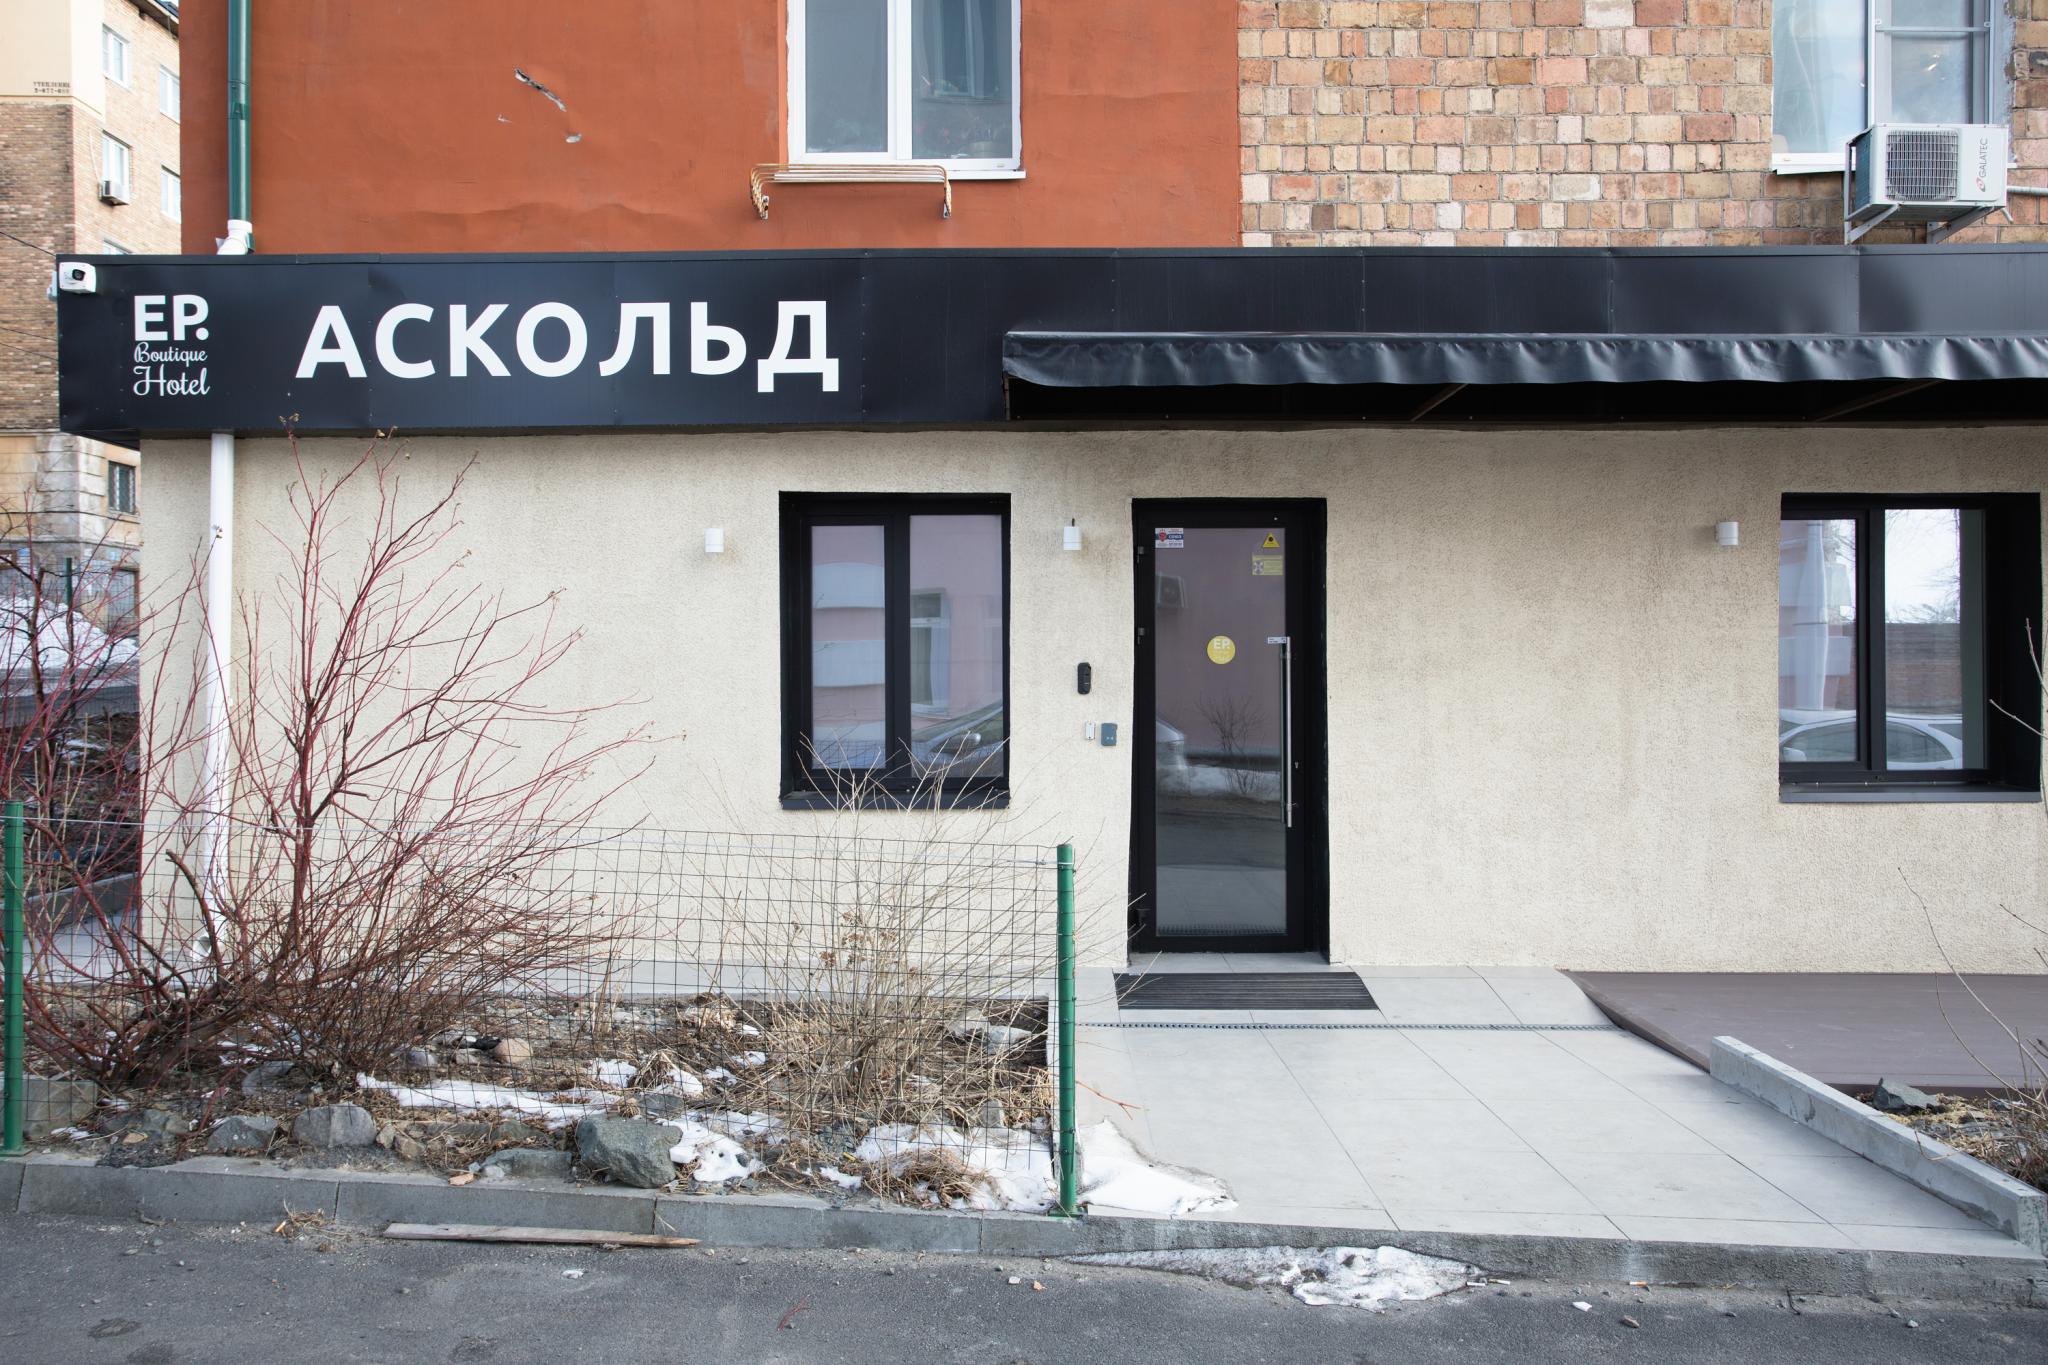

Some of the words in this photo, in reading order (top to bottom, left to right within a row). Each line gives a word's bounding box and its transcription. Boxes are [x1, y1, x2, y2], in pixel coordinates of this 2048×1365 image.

[1979, 137, 1988, 178] GALATEC
[134, 294, 210, 341] EP.
[133, 341, 208, 368] Boutique
[295, 300, 840, 393] АСКОЛЬД
[133, 364, 211, 397] Hotel
